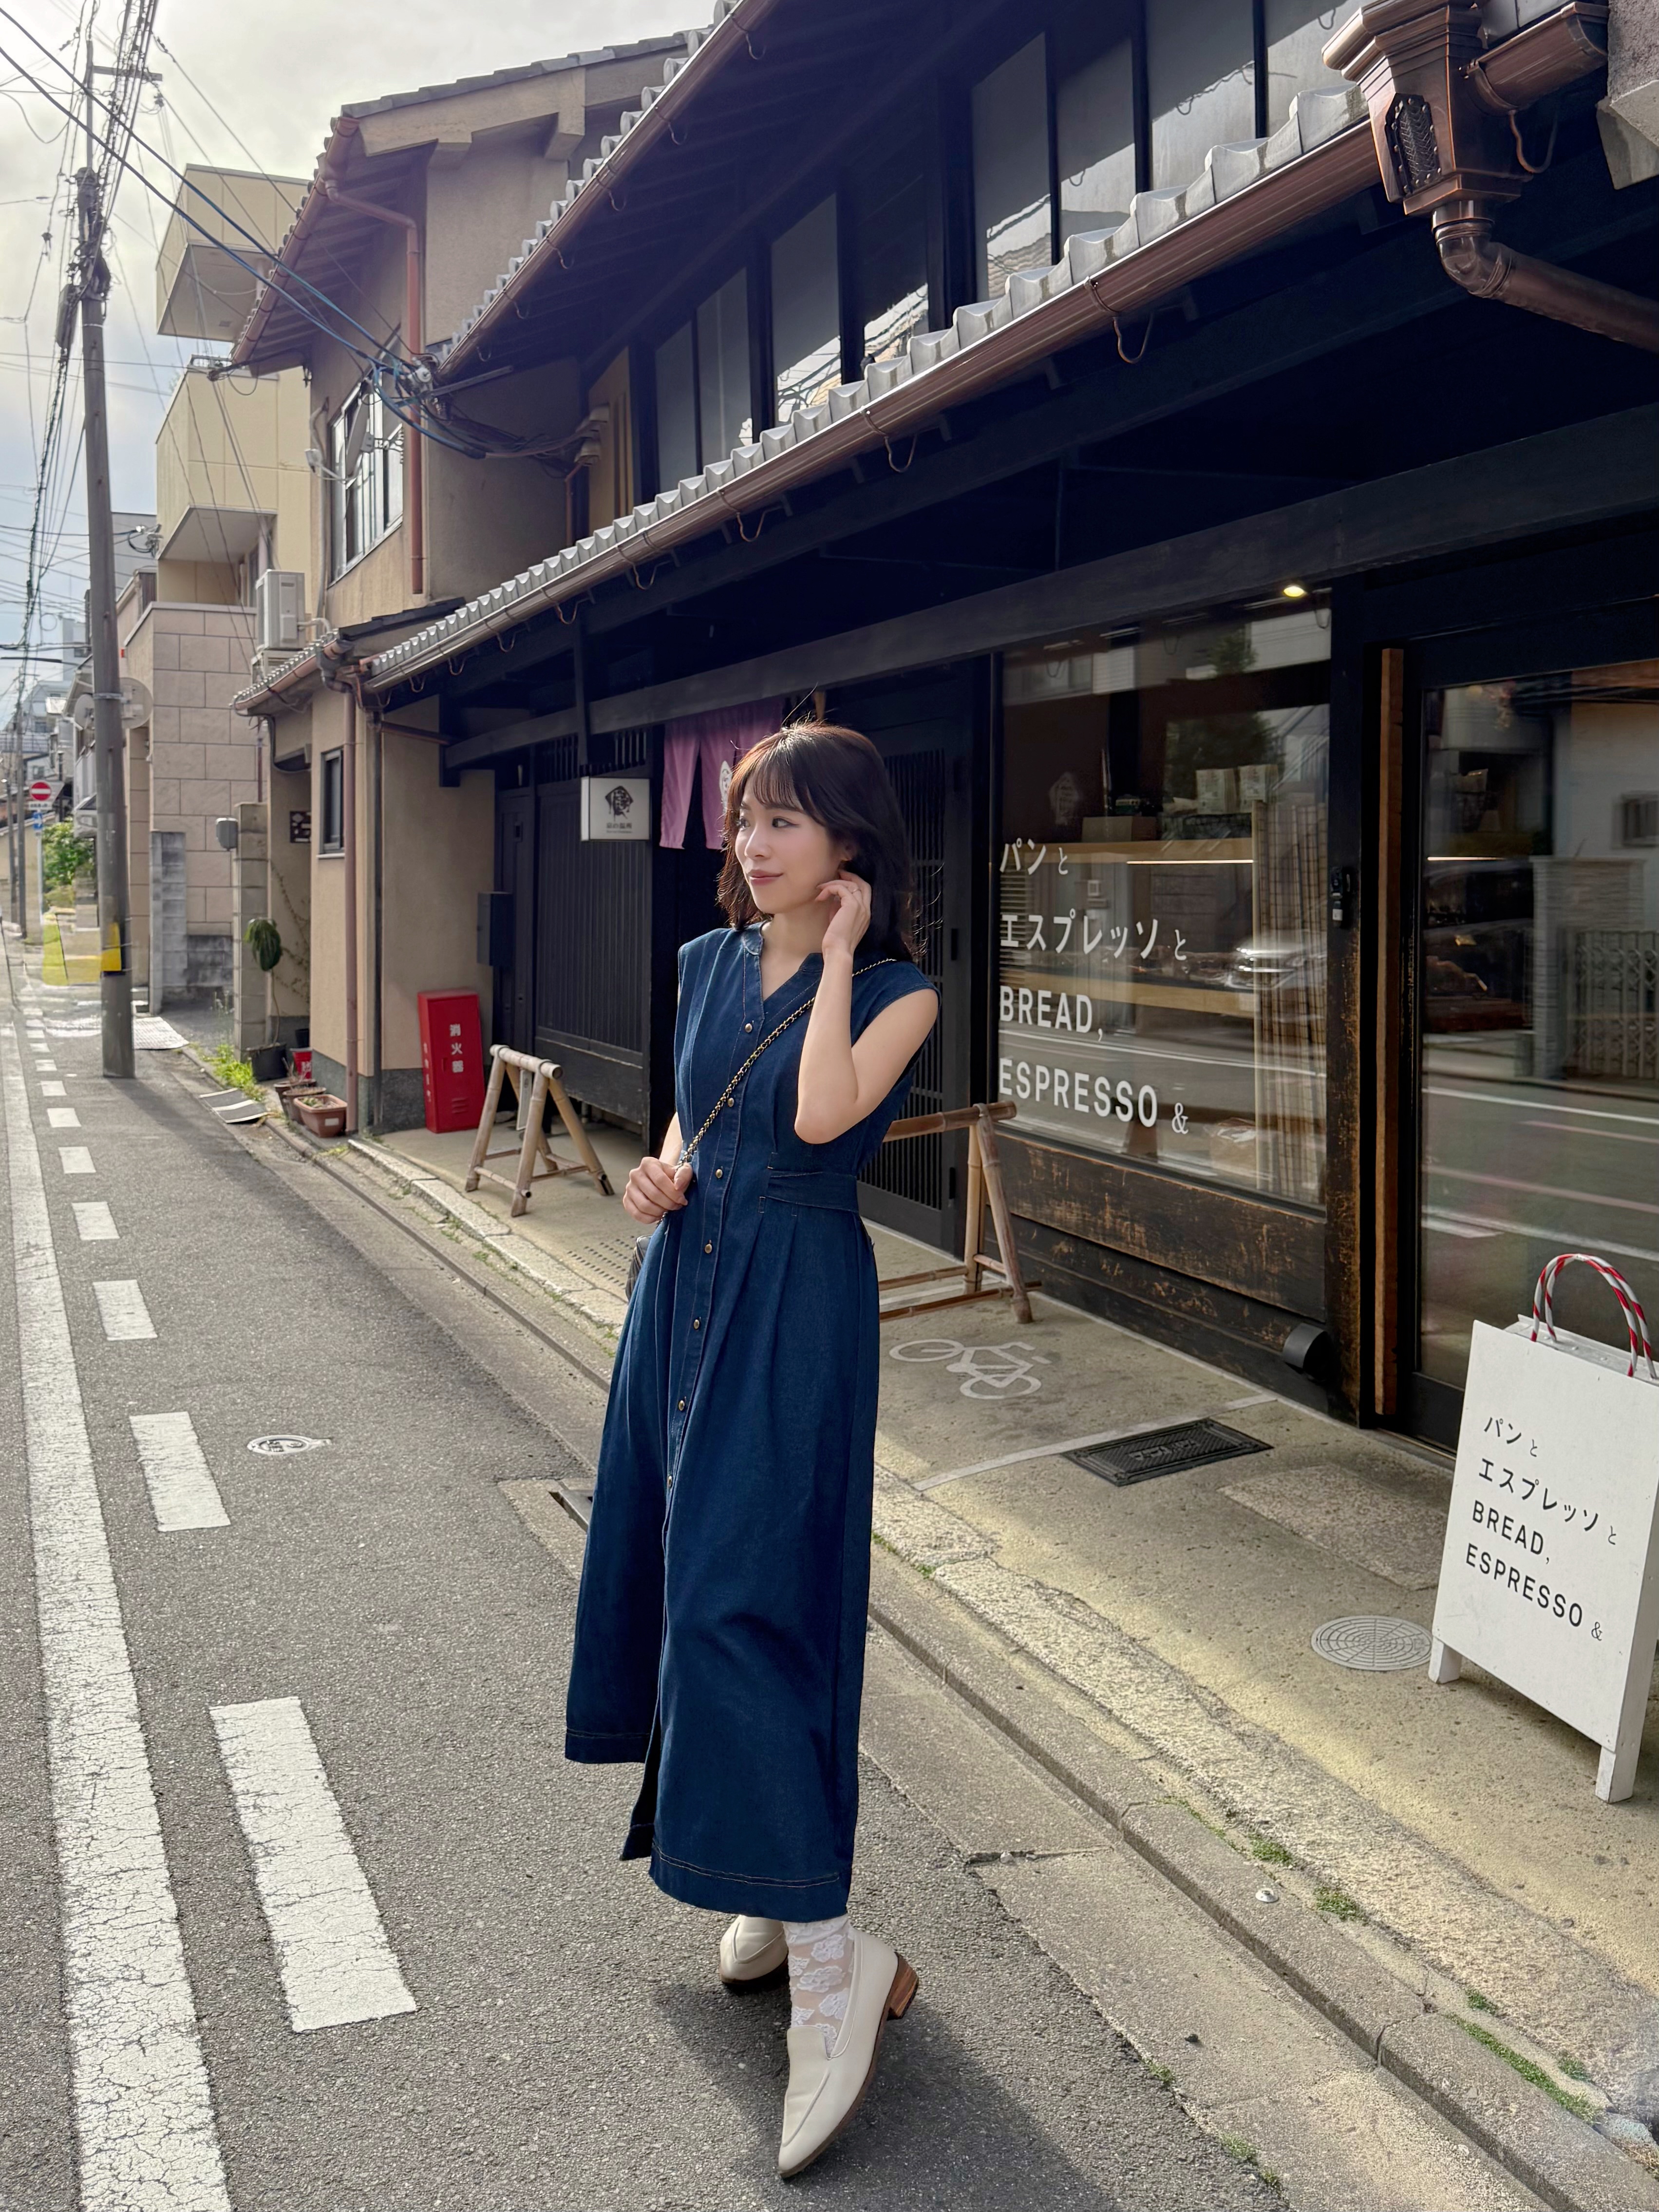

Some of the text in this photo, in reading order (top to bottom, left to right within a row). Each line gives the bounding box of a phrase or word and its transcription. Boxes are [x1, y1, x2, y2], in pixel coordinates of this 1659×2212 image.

[999, 837, 1068, 875] パンと
[1000, 908, 1187, 961] エスプレッソと
[1000, 985, 1103, 1041] BREAD,
[450, 1024, 464, 1073] 消火器
[999, 1058, 1188, 1134] ESPRESSO &
[1484, 1417, 1538, 1457] パンと
[1479, 1458, 1616, 1545] エスプレッソと
[1472, 1500, 1549, 1564] BREAD,
[1466, 1543, 1602, 1641] ESPRESSO &
